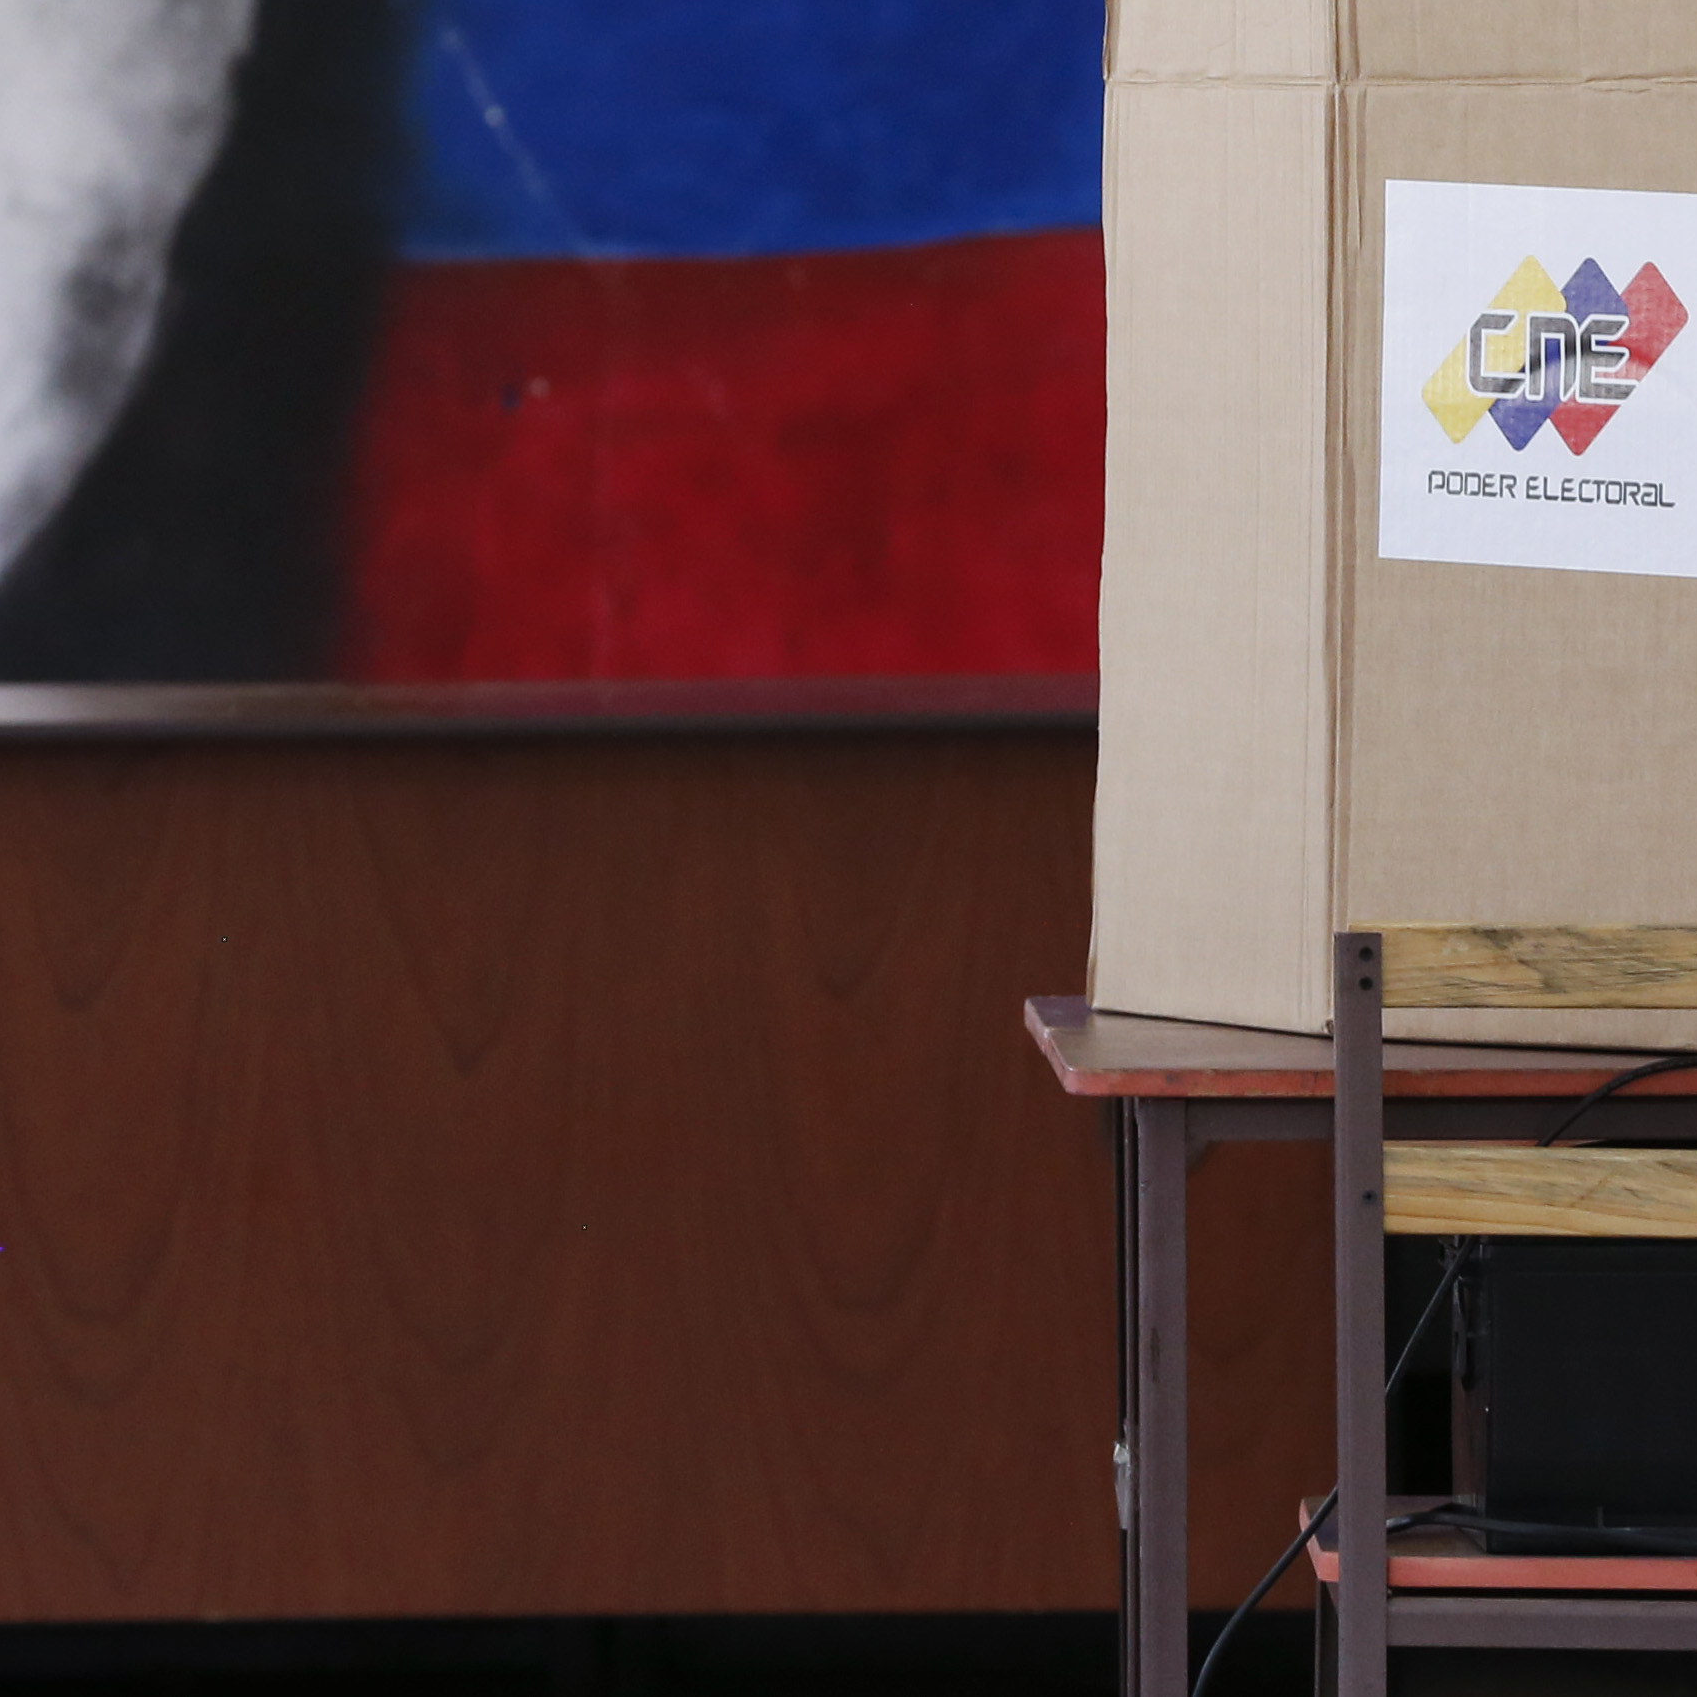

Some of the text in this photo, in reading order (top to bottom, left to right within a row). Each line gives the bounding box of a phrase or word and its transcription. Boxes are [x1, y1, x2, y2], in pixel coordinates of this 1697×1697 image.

[1469, 312, 1638, 401] CNE
[1427, 469, 1676, 509] PODER ELECTORAL
